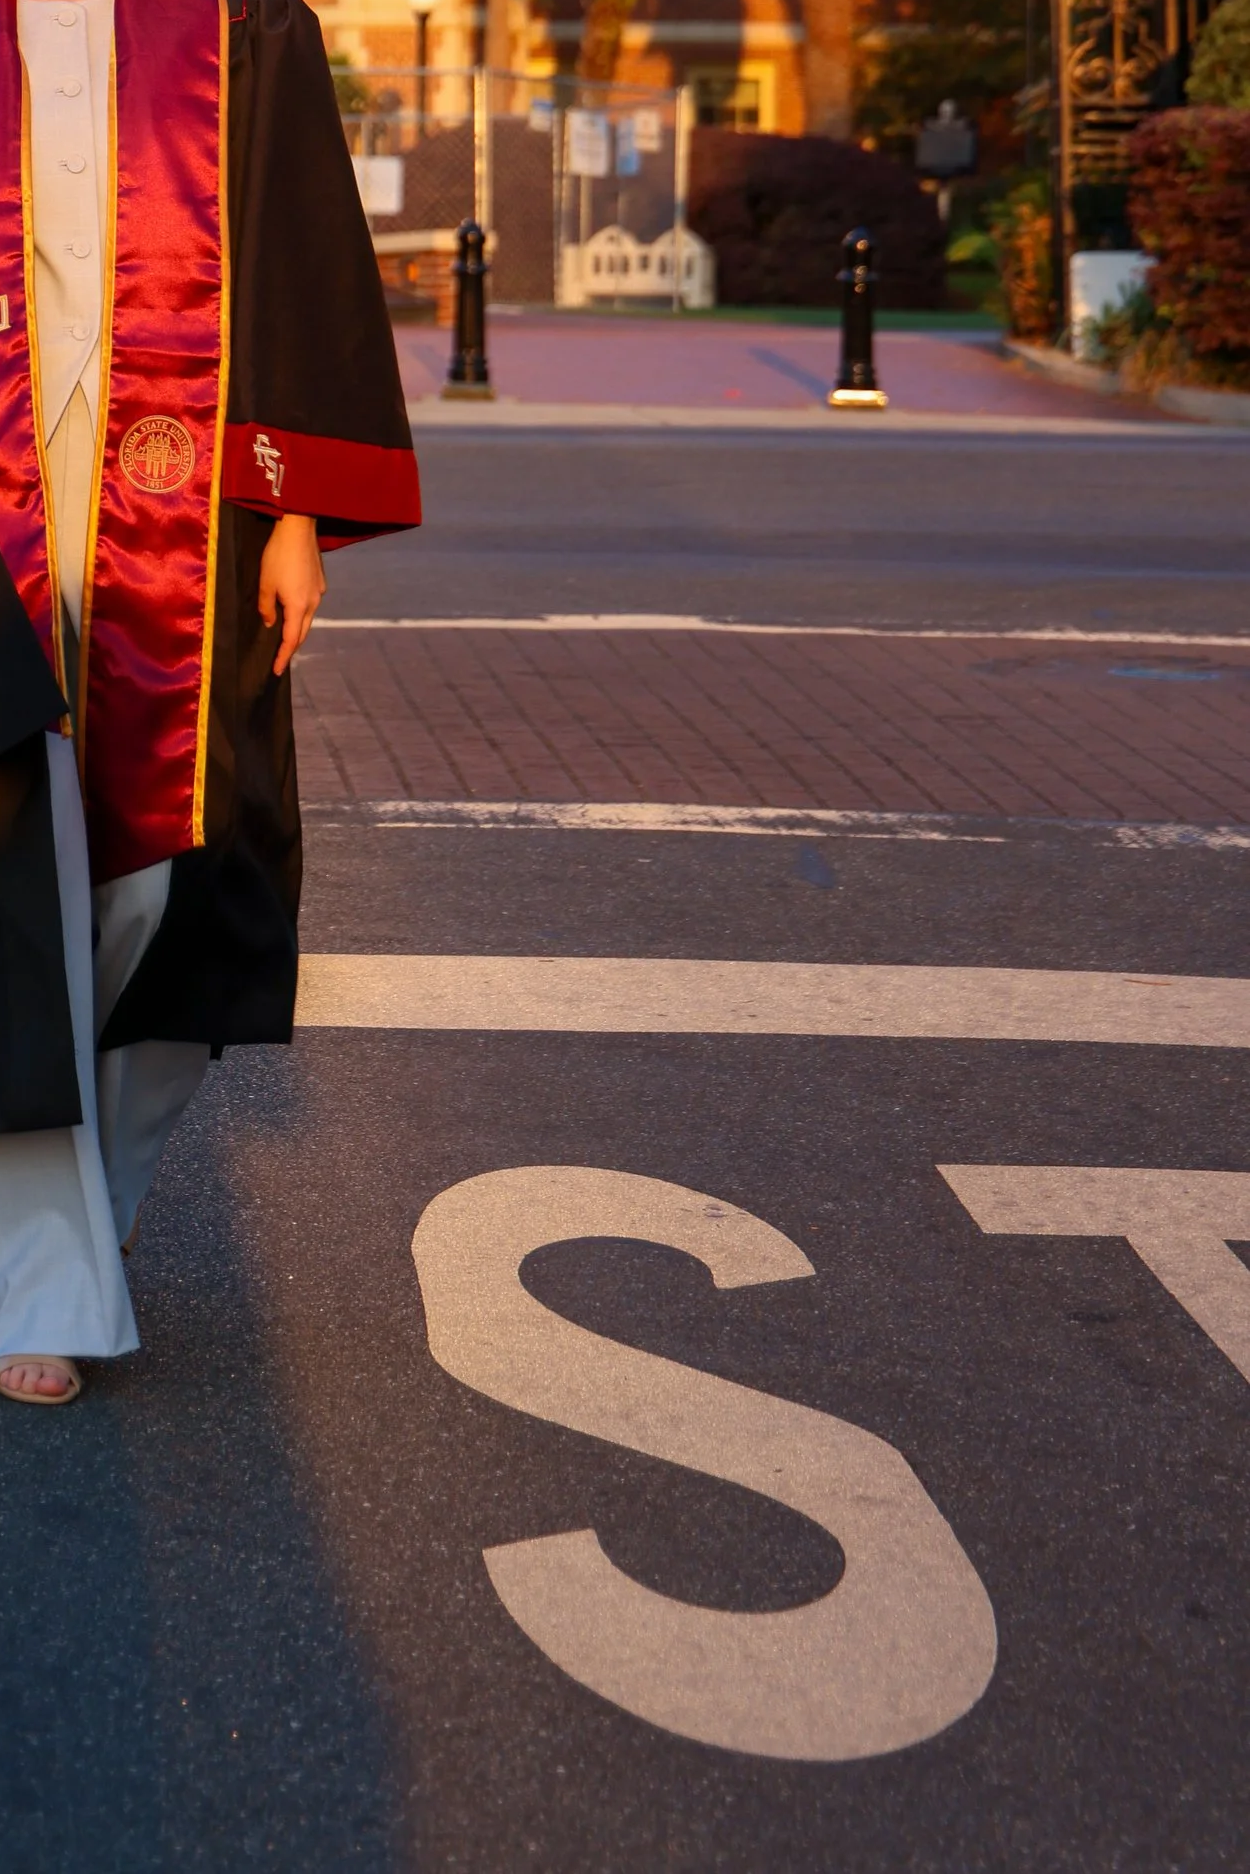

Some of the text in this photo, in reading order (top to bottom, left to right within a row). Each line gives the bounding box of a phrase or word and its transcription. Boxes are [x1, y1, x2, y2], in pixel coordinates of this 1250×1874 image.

[124, 421, 190, 478] FLORIDA STATE UNIVERSITY
[252, 433, 285, 497] FSU
[146, 480, 164, 489] 1851
